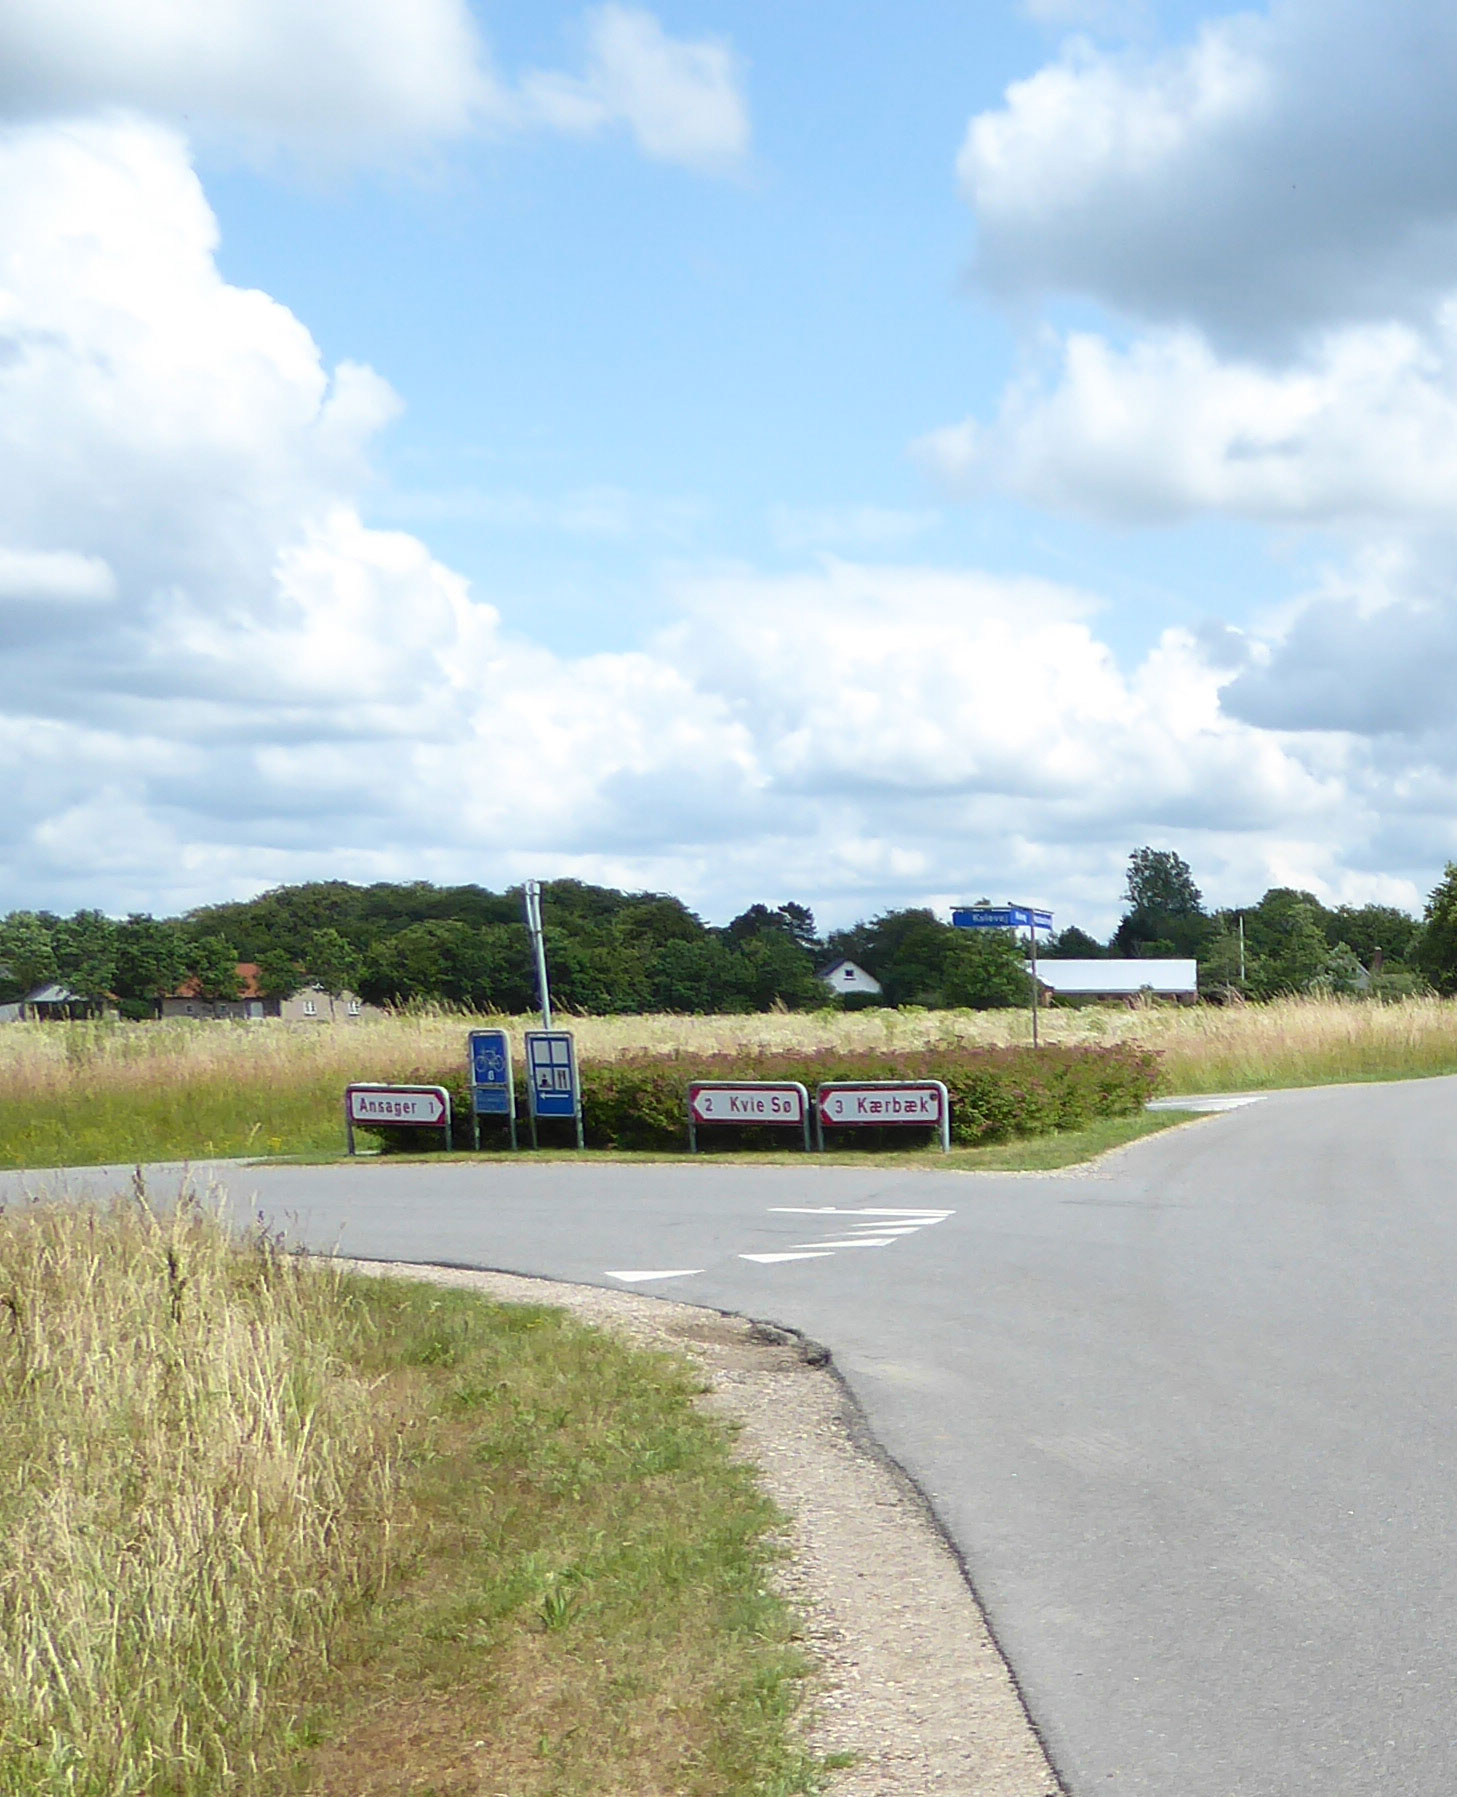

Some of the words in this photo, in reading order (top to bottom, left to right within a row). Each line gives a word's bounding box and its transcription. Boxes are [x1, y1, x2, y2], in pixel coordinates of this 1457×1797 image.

[360, 1097, 417, 1117] Ansager
[428, 1102, 435, 1114] 1
[704, 1099, 714, 1112] 2
[730, 1096, 765, 1113] Kvie
[771, 1096, 792, 1113] Sø
[834, 1100, 844, 1114] 3
[857, 1097, 930, 1113] Kærbæk
